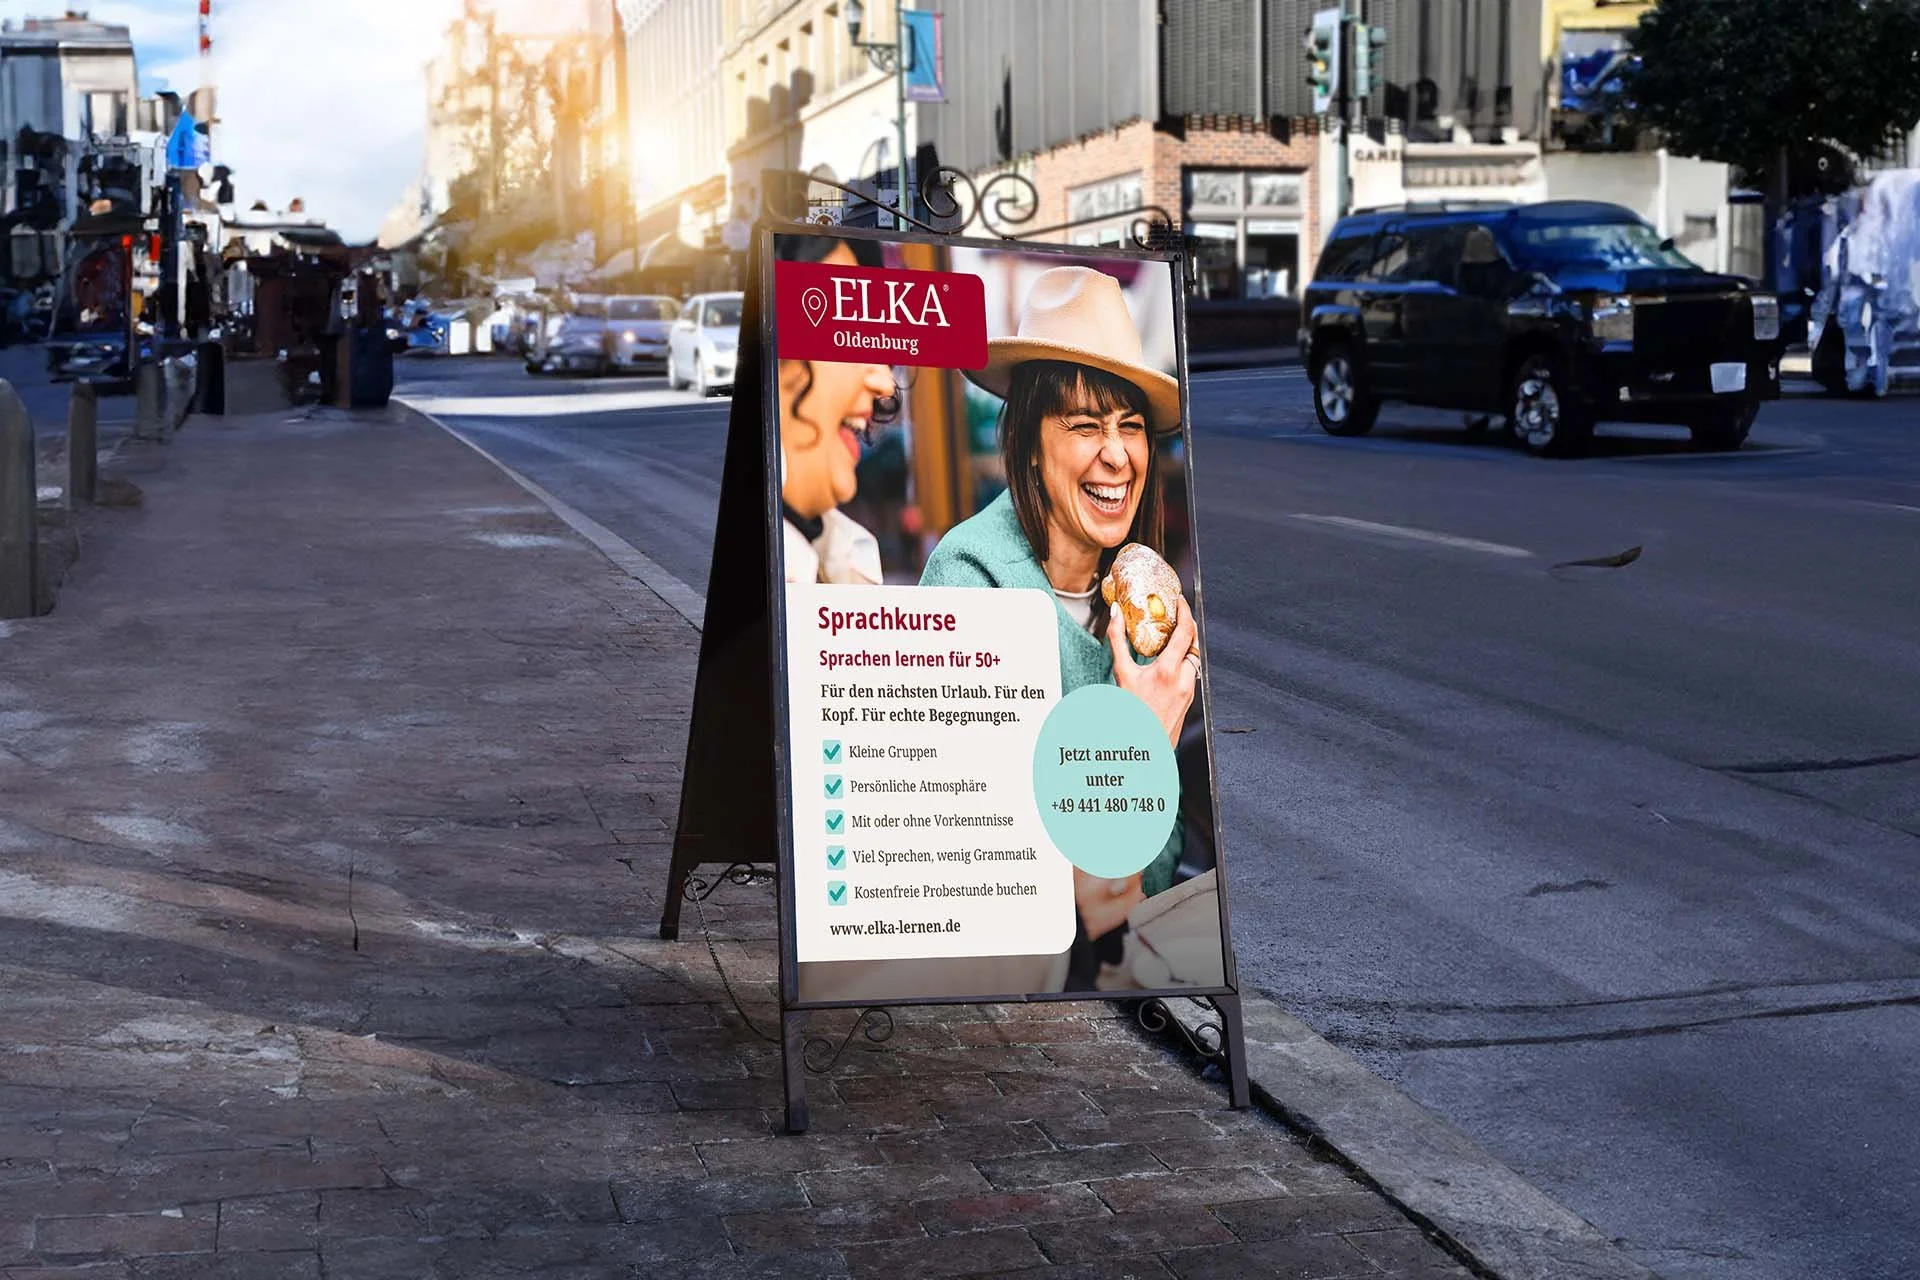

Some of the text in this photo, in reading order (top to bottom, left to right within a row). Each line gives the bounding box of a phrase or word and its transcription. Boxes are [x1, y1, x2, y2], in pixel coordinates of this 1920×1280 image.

[834, 331, 918, 355] Oldenburg
[819, 607, 956, 636] Sprachkurse
[820, 650, 1000, 670] Sprachen lernen für 50+
[821, 684, 1045, 699] Für den nächsten Urlaub. Für den
[822, 707, 1020, 726] Kopf. Für echte Begegnungen.
[849, 745, 937, 761] Kleine Gruppen
[1060, 746, 1150, 765] Jetzt anrufen
[851, 779, 986, 795] Persönliche Atmosphäre
[1086, 774, 1124, 786] unter
[1052, 798, 1165, 812] +49 441 480 748 0
[852, 814, 1013, 827] Mit oder ohne Vorkenntnisse
[853, 848, 1036, 866] Viel Sprechen, wenig Grammatik
[855, 883, 1037, 898] Kostenfreie Probestunde buchen
[830, 919, 960, 935] www.elka-lernen.de
